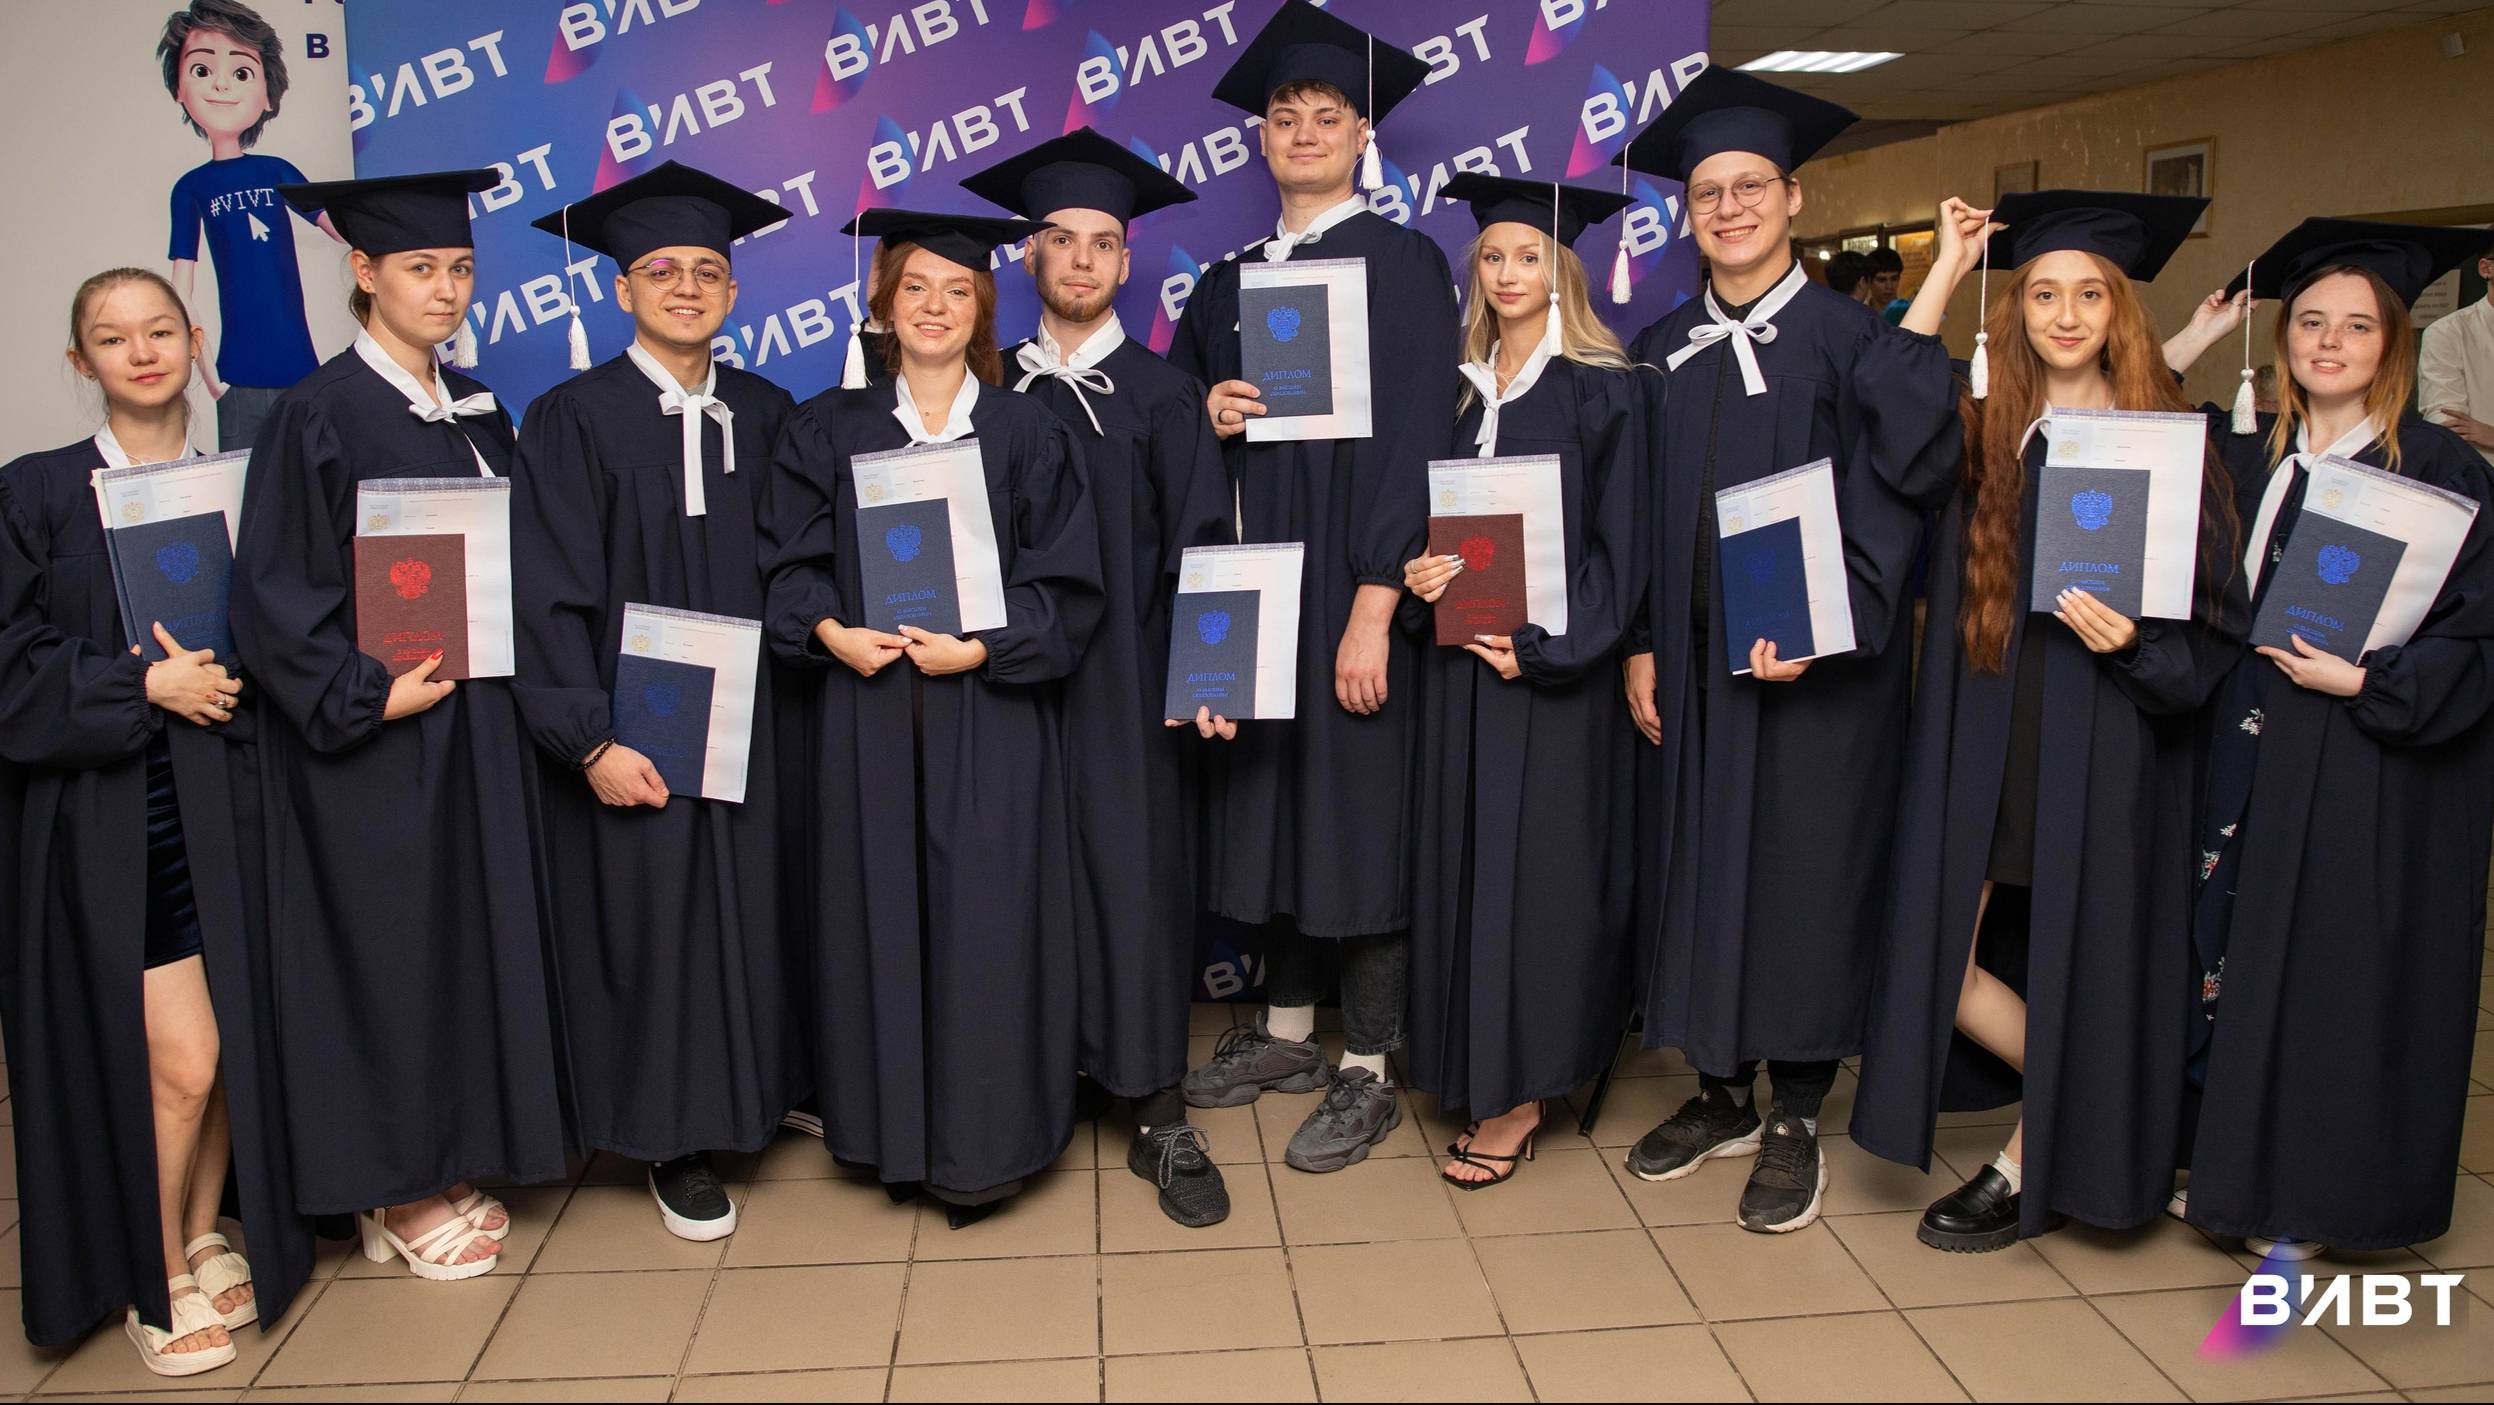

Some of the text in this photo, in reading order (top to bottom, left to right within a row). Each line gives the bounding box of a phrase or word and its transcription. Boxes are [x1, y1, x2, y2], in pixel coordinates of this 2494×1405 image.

[1076, 0, 1239, 105] ВИВТ
[1411, 14, 1492, 93] ВТ
[606, 61, 777, 164] ВИВТ
[867, 86, 1030, 190] ВИВТ
[210, 188, 275, 217] #VIVT
